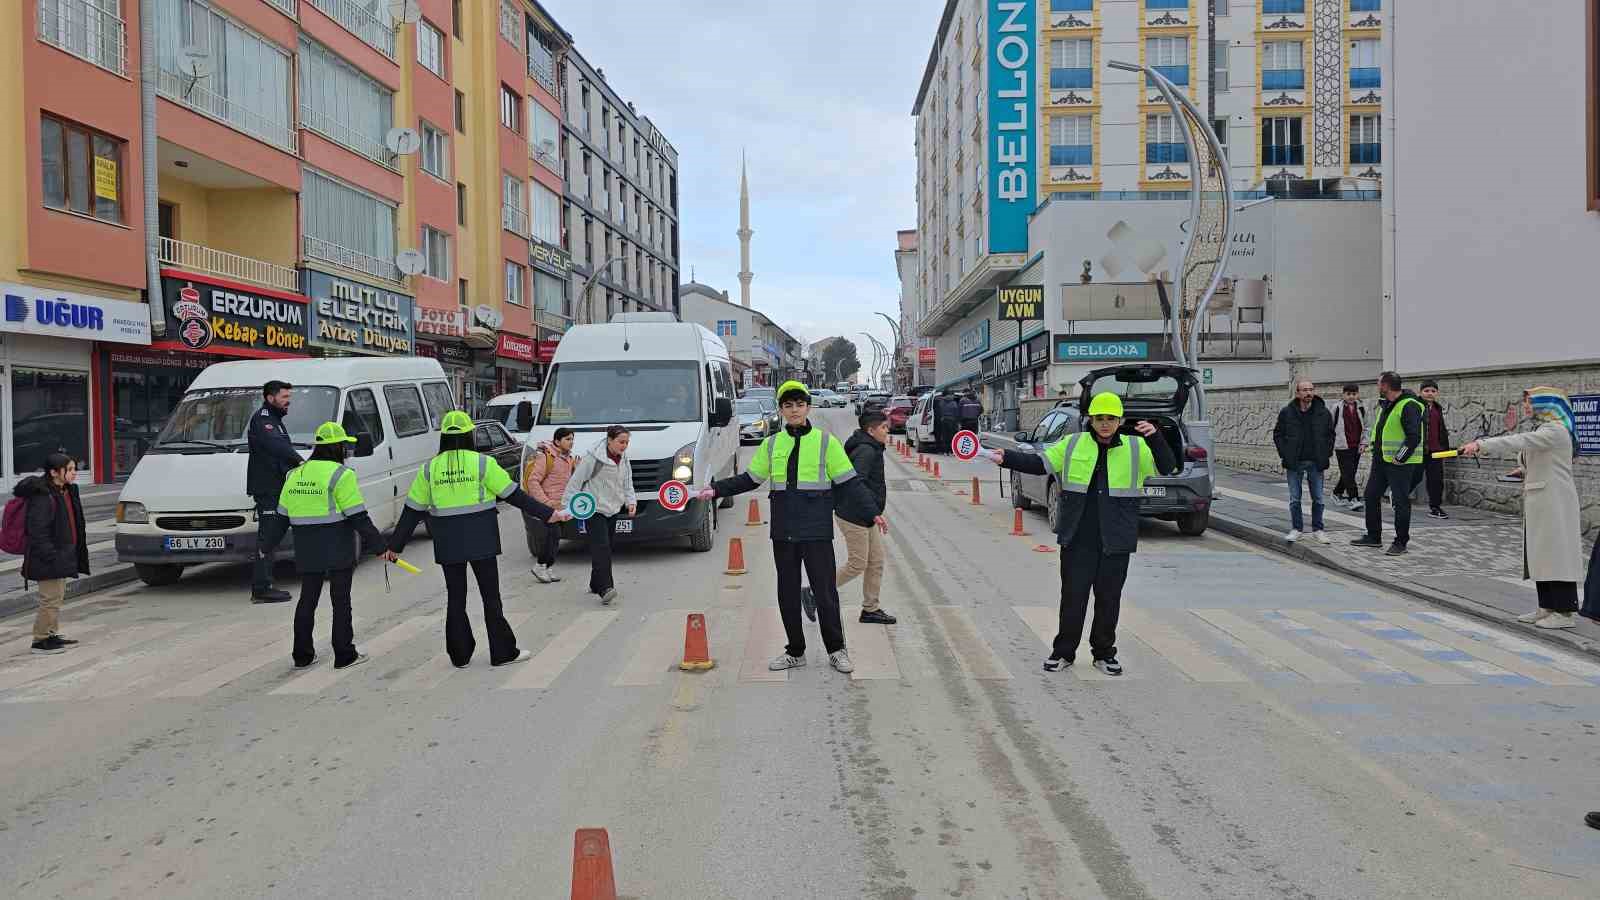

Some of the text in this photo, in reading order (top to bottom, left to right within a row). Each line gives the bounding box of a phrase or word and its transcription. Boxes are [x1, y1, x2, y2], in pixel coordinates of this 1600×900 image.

[332, 280, 399, 312] MUTLU
[999, 288, 1042, 304] UYGUN
[35, 297, 104, 331] UĞUR
[211, 289, 303, 325] ERZURUM
[319, 298, 408, 332] ELEKTRİK
[421, 308, 456, 323] FOTO
[1005, 303, 1036, 318] AVM
[319, 319, 359, 343] Avize
[364, 327, 411, 353] Dünyası
[1014, 343, 1028, 371] AM
[1067, 344, 1139, 356] BELLONA
[1573, 399, 1599, 412] DİKKAT
[960, 436, 973, 455] STOP
[668, 486, 681, 504] STOP
[187, 538, 199, 548] LY
[204, 538, 223, 548] 230
